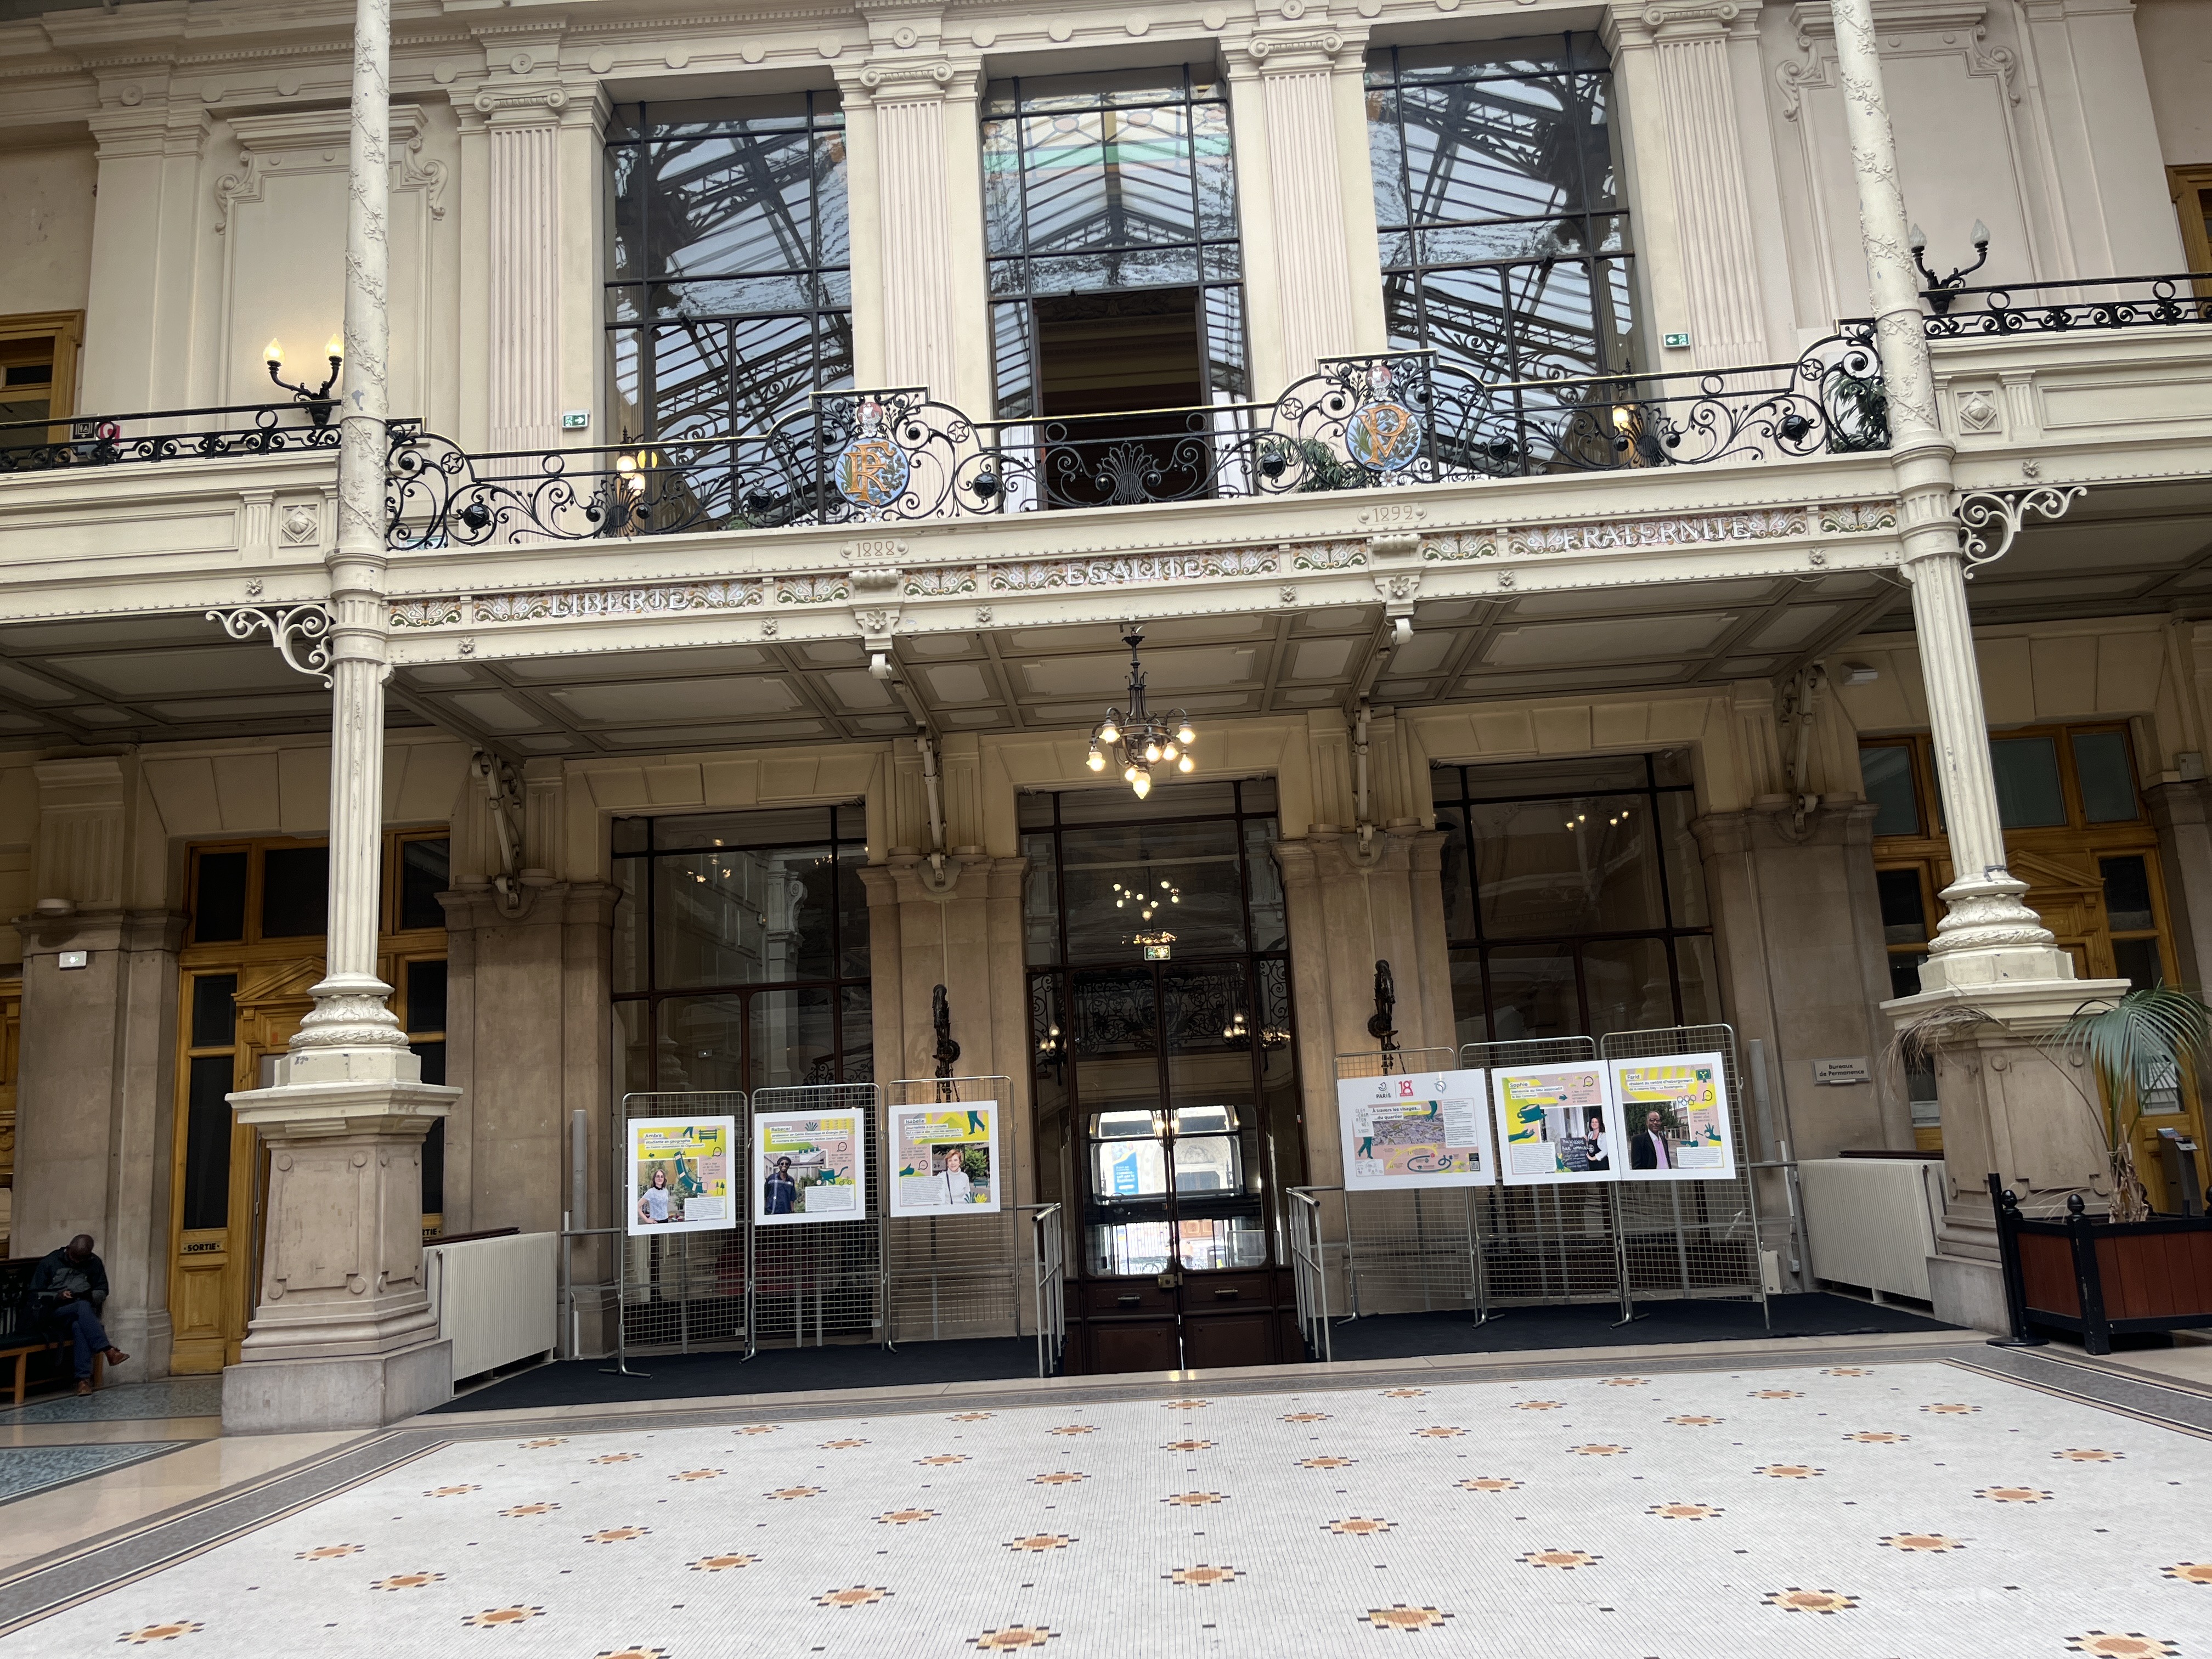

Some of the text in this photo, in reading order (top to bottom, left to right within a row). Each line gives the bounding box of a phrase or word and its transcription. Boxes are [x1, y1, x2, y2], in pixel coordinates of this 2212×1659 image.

[1372, 505, 1413, 522] 1892
[1563, 515, 1752, 549] FRATERNITE
[856, 540, 895, 557] 1888
[1066, 555, 1202, 584] EGALITE
[550, 588, 687, 616] LIBERTE
[187, 1243, 216, 1251] SORTIE
